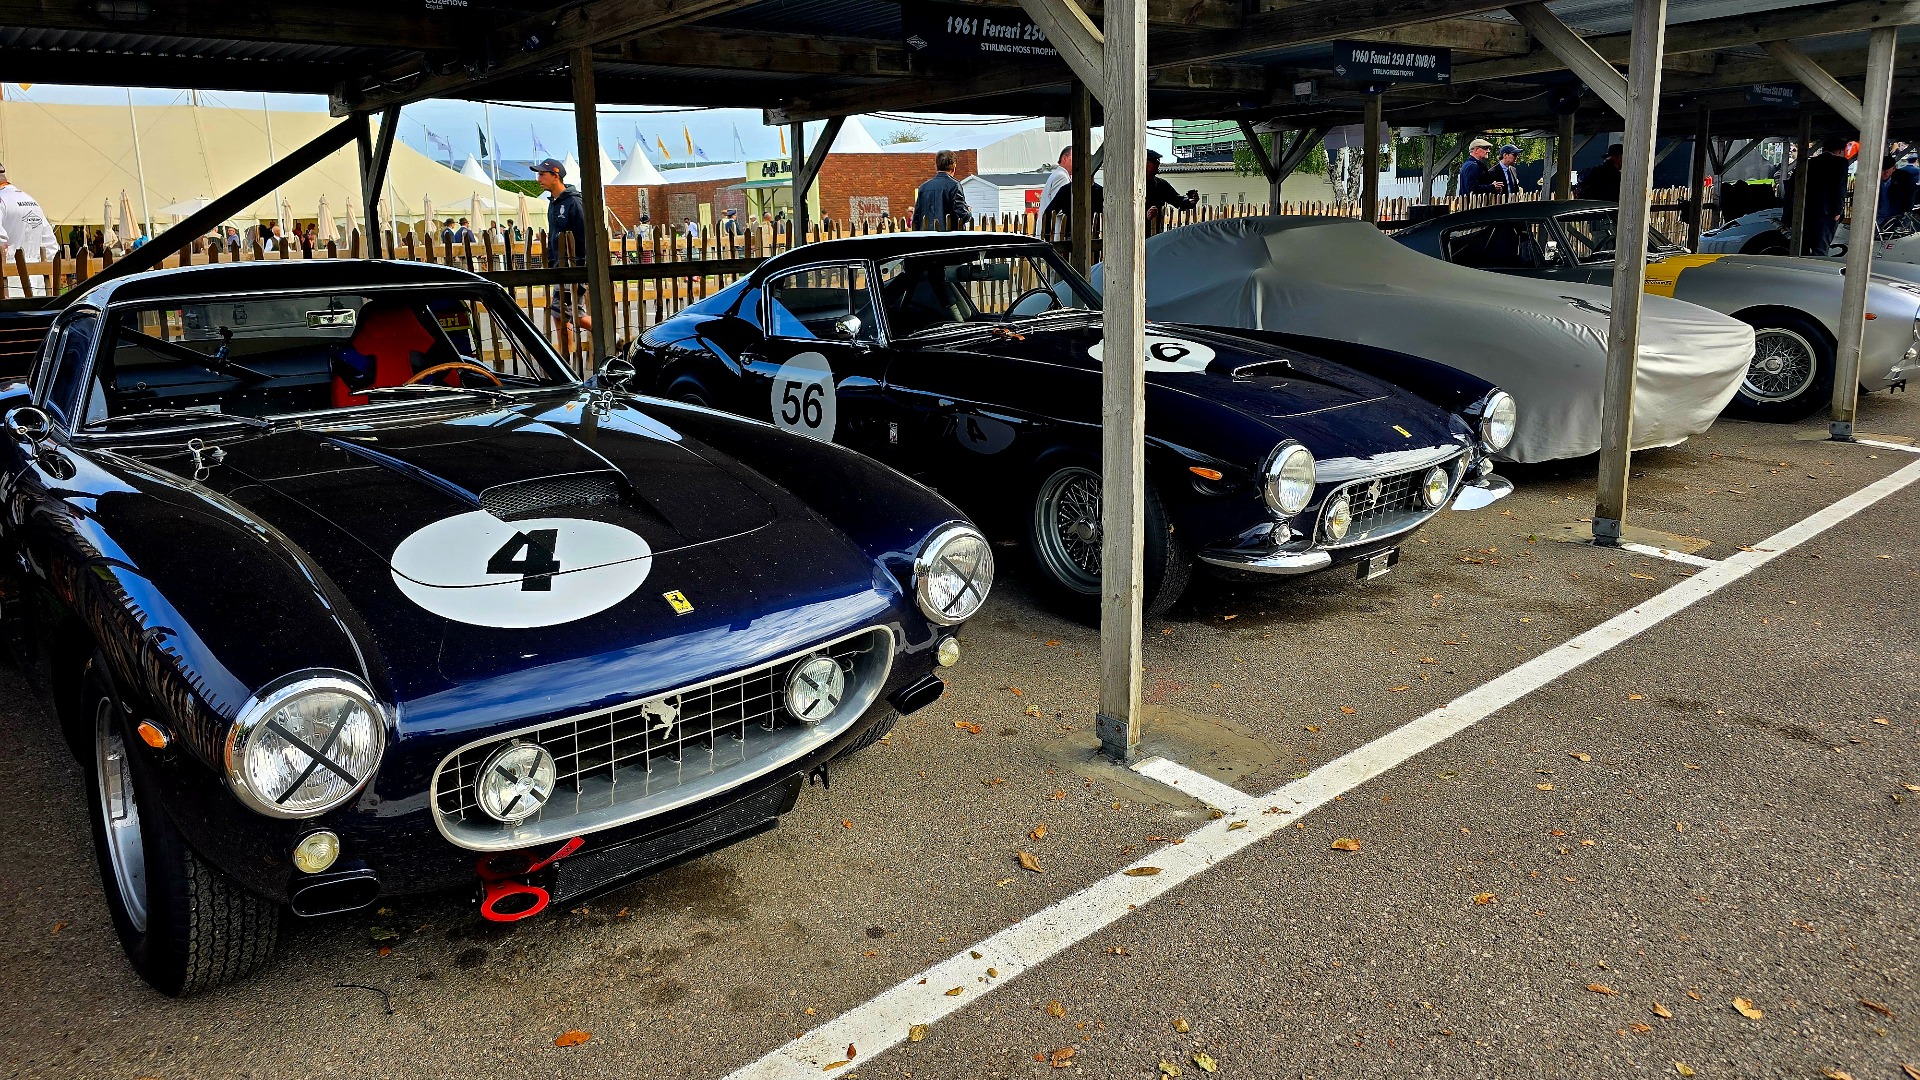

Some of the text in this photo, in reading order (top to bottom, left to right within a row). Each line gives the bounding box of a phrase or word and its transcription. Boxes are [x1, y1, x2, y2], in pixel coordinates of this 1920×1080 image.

[947, 16, 978, 36] 1961
[982, 18, 1021, 39] Ferrari
[980, 42, 1058, 56] STIRLING MOSS TROPHY
[1351, 49, 1369, 63] 1960
[1370, 50, 1391, 65] Ferrari
[1391, 53, 1405, 66] 250
[1405, 53, 1414, 67] GT
[438, 313, 460, 327] ari
[780, 380, 825, 429] 56
[486, 528, 560, 592] 4
